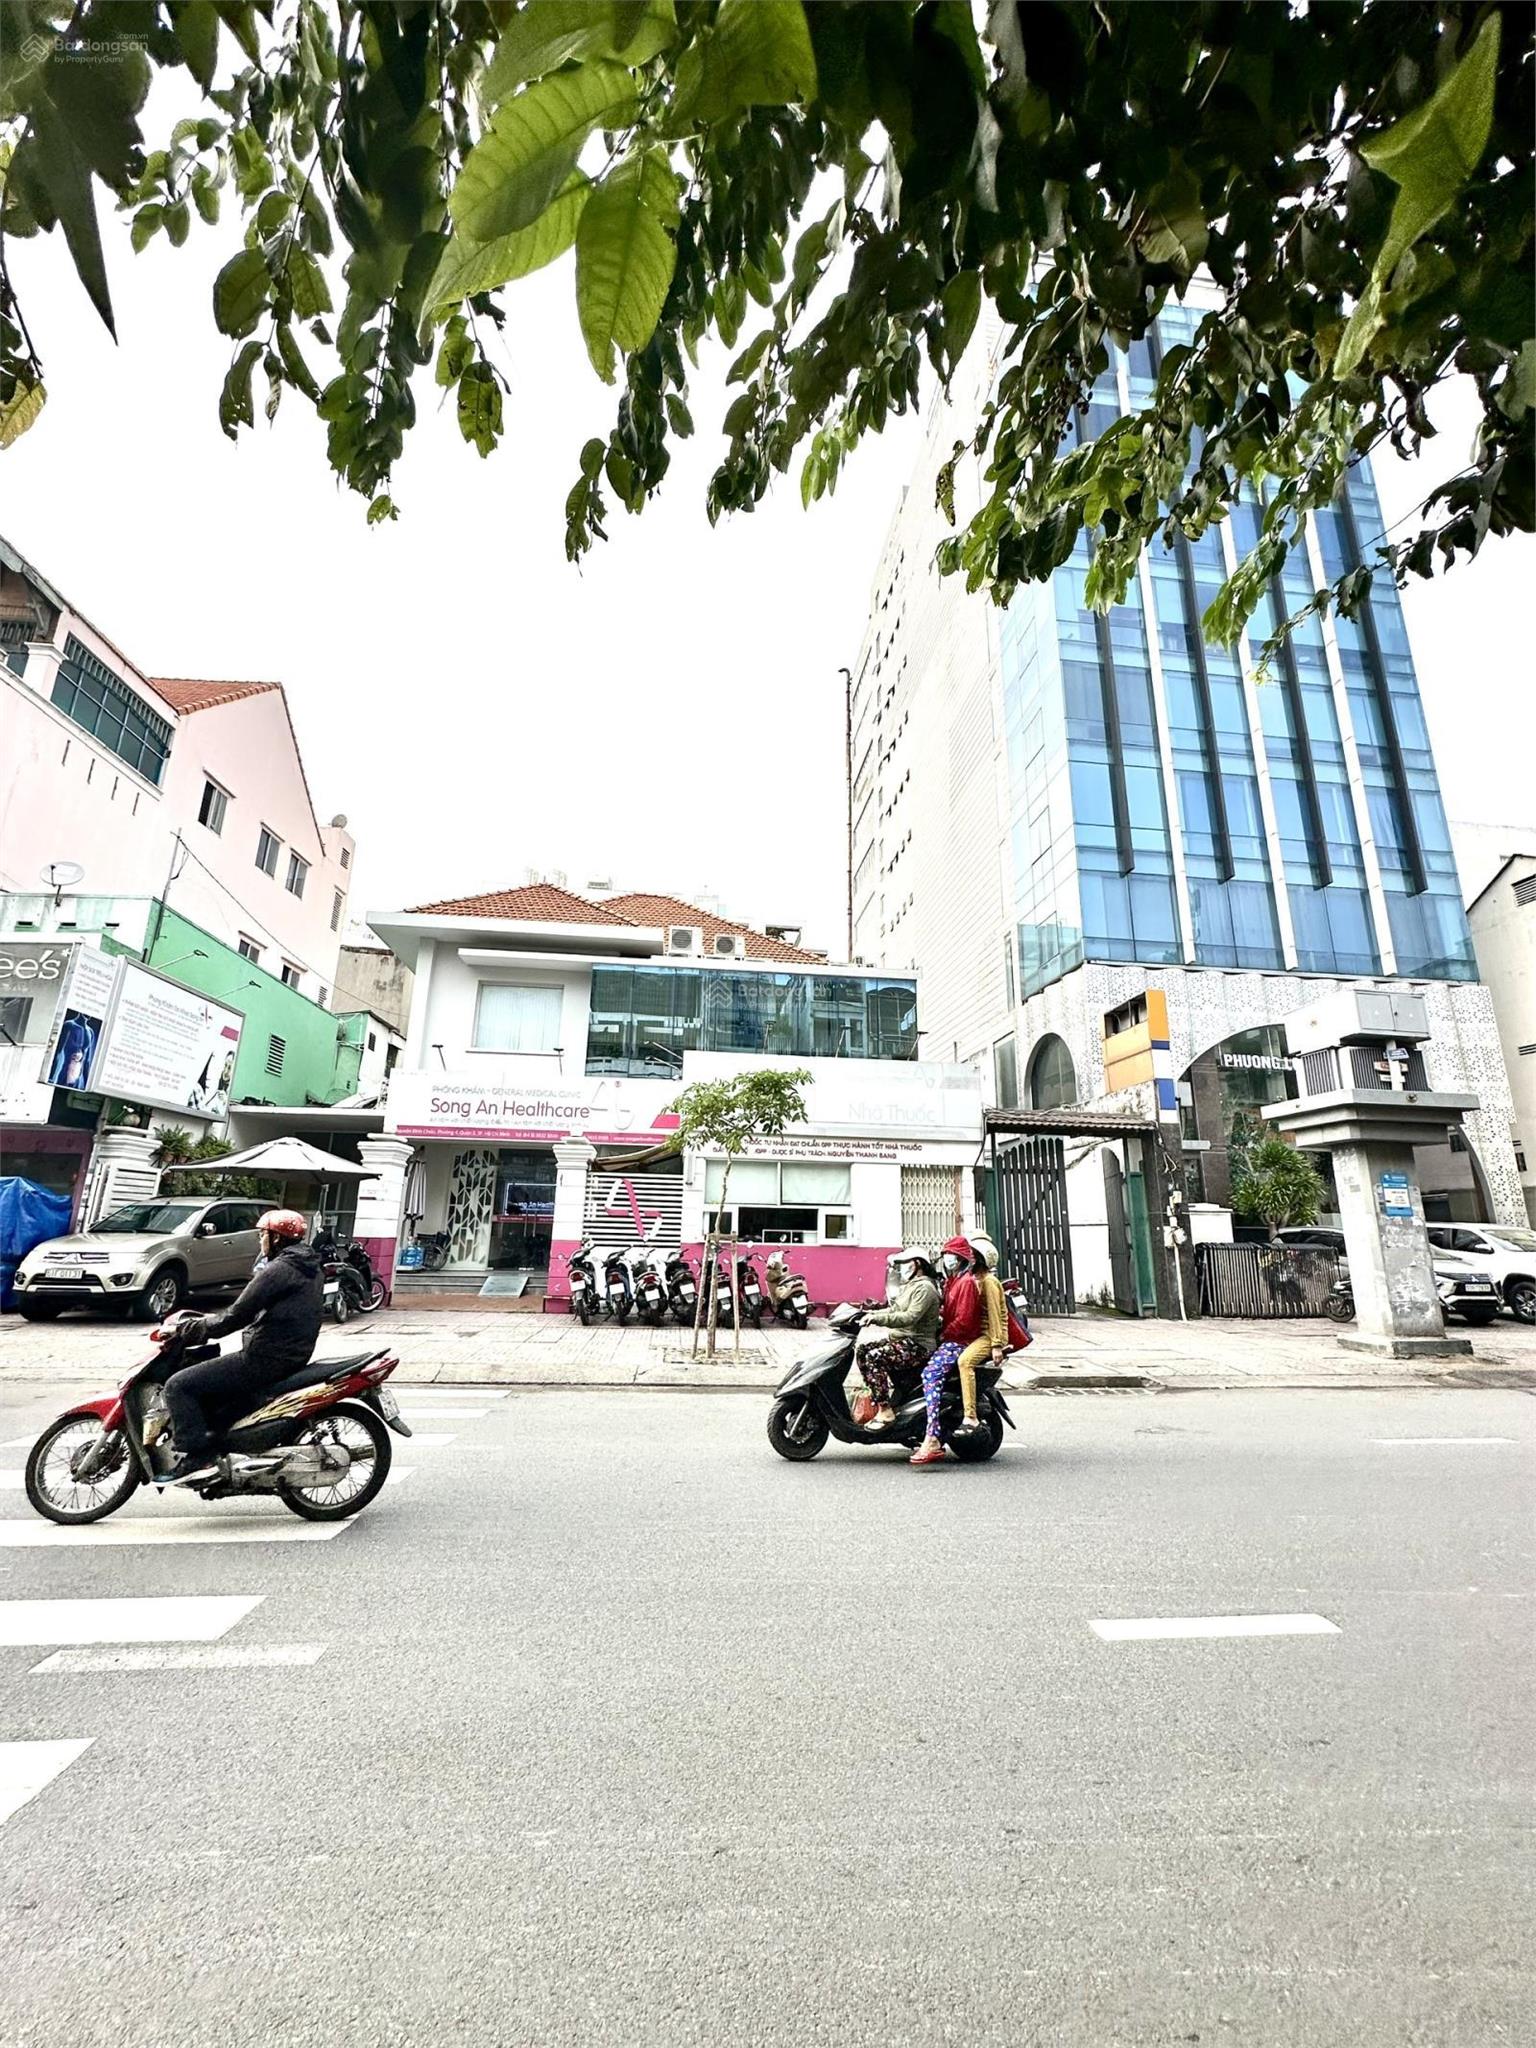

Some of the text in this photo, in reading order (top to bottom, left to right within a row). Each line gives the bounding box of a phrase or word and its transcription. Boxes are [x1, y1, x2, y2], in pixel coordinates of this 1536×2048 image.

[430, 1097, 591, 1119] Song An Healthcare
